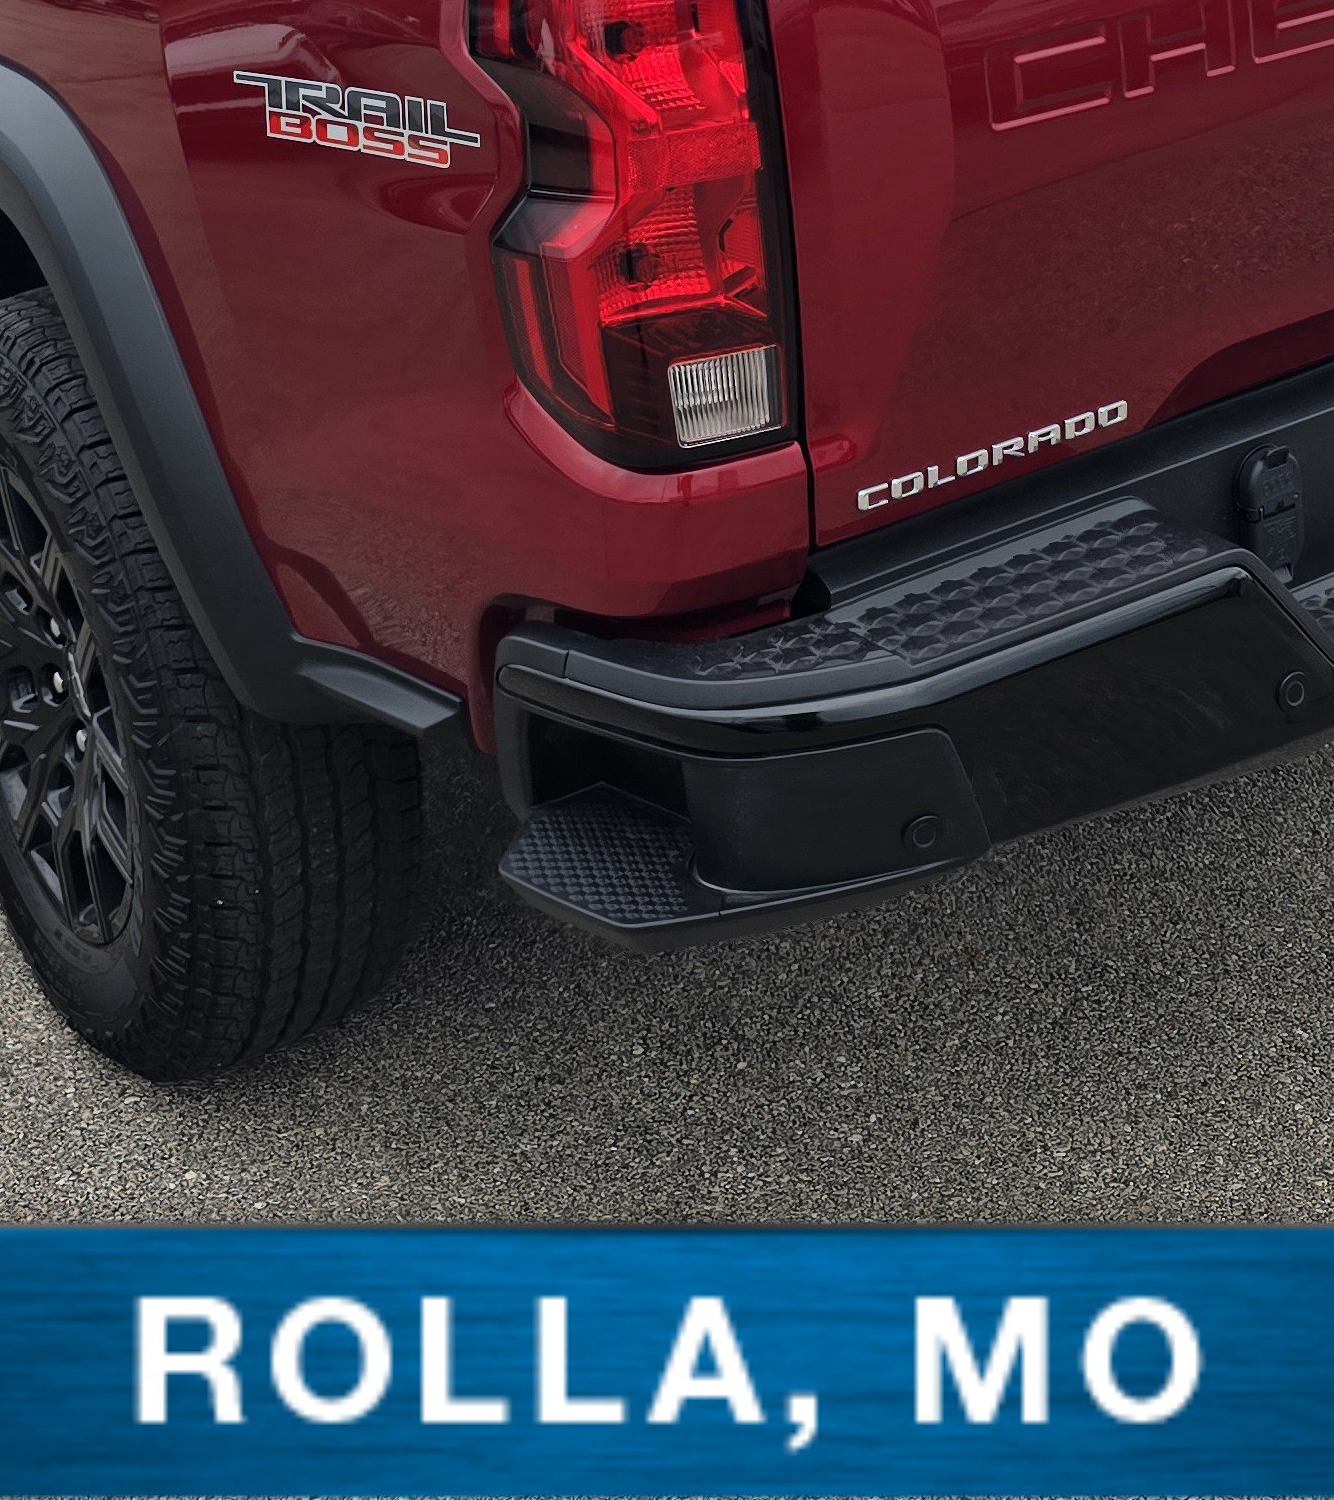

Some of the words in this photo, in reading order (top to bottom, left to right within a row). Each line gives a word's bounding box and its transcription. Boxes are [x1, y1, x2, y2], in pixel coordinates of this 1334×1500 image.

[233, 70, 481, 148] TRAIL
[267, 110, 451, 169] BOSS
[857, 399, 1129, 512] COLORADO
